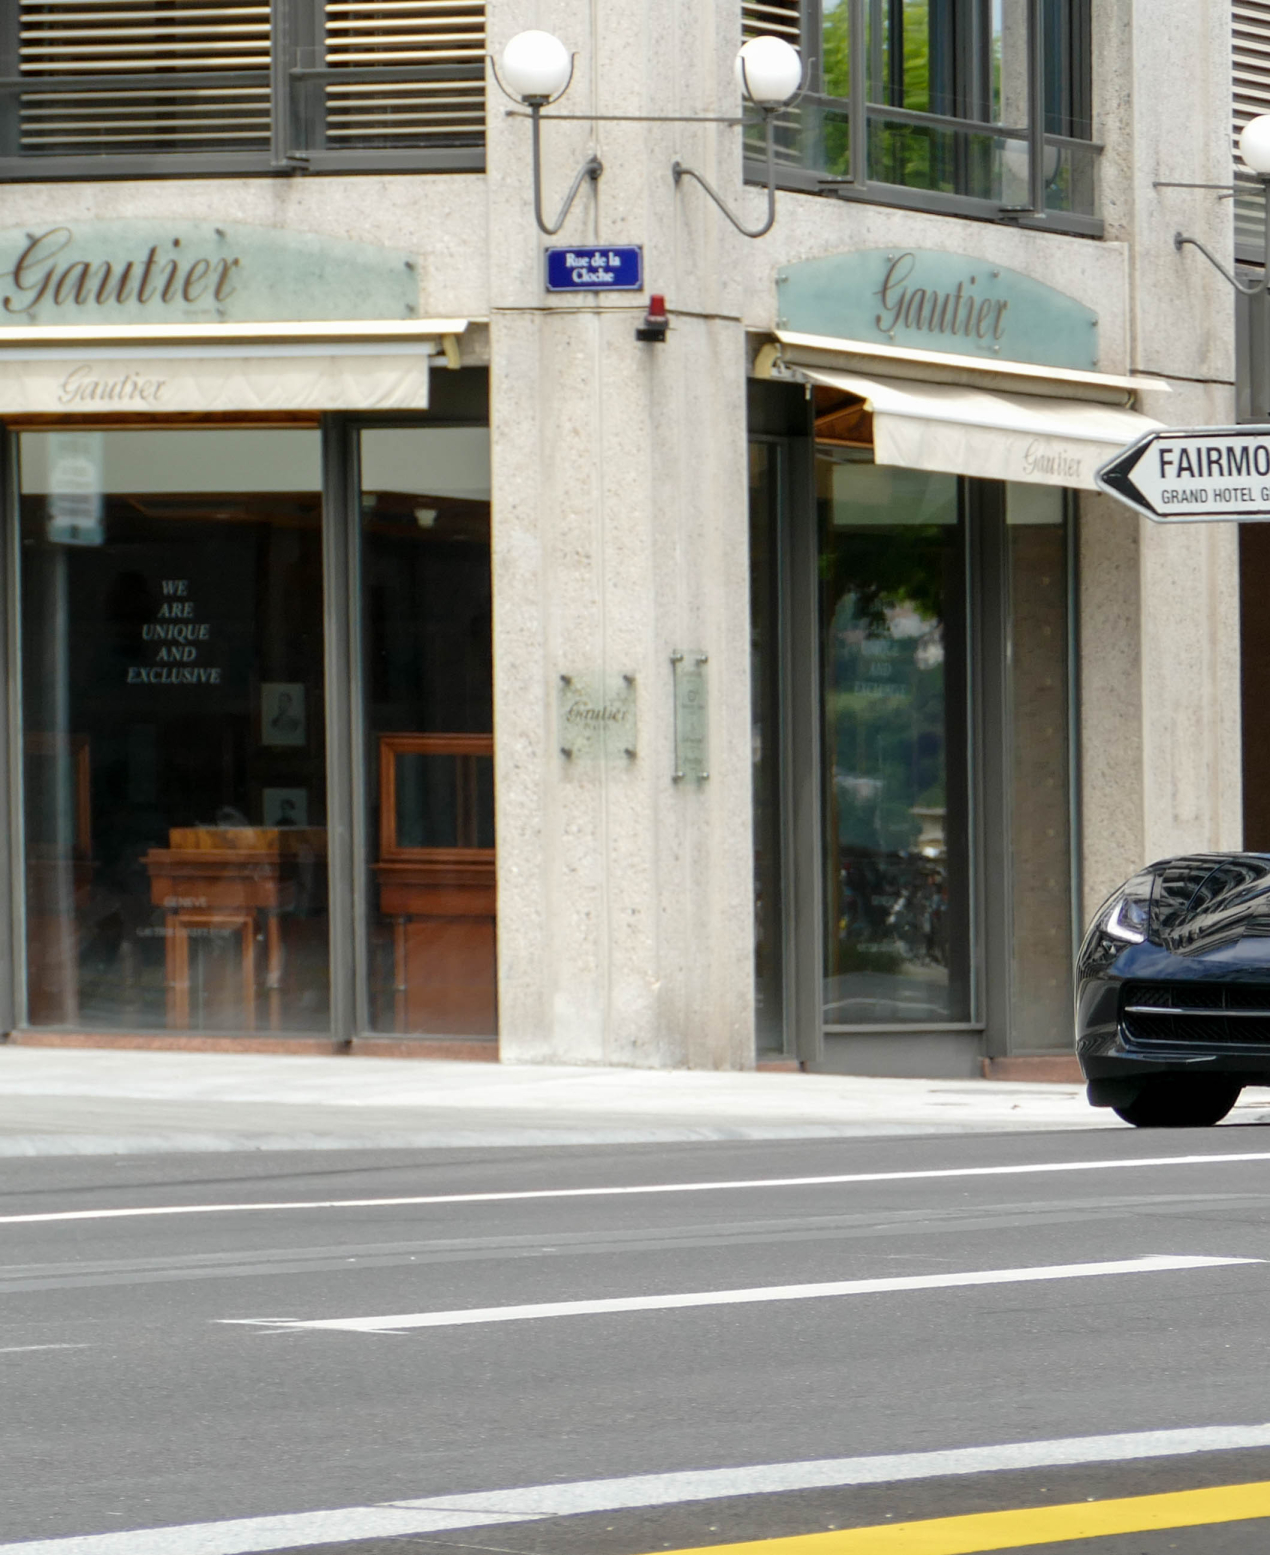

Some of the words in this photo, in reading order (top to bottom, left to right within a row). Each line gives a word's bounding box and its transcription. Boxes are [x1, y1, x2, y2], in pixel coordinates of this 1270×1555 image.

[565, 252, 589, 268] Rue
[590, 251, 607, 267] de
[608, 251, 621, 267] la
[0, 226, 240, 314] Gautier
[572, 267, 615, 283] Cloche
[872, 252, 1009, 341] Gautier
[58, 364, 166, 405] Gautier
[1022, 438, 1082, 479] Gautier
[1161, 489, 1208, 505] GRAND
[1213, 487, 1256, 503] HOTEL
[162, 579, 188, 597] WE
[157, 601, 194, 618] ARE
[142, 623, 211, 644] UNIQUE
[156, 645, 197, 662] AND
[127, 667, 222, 684] EXCLUSIVE
